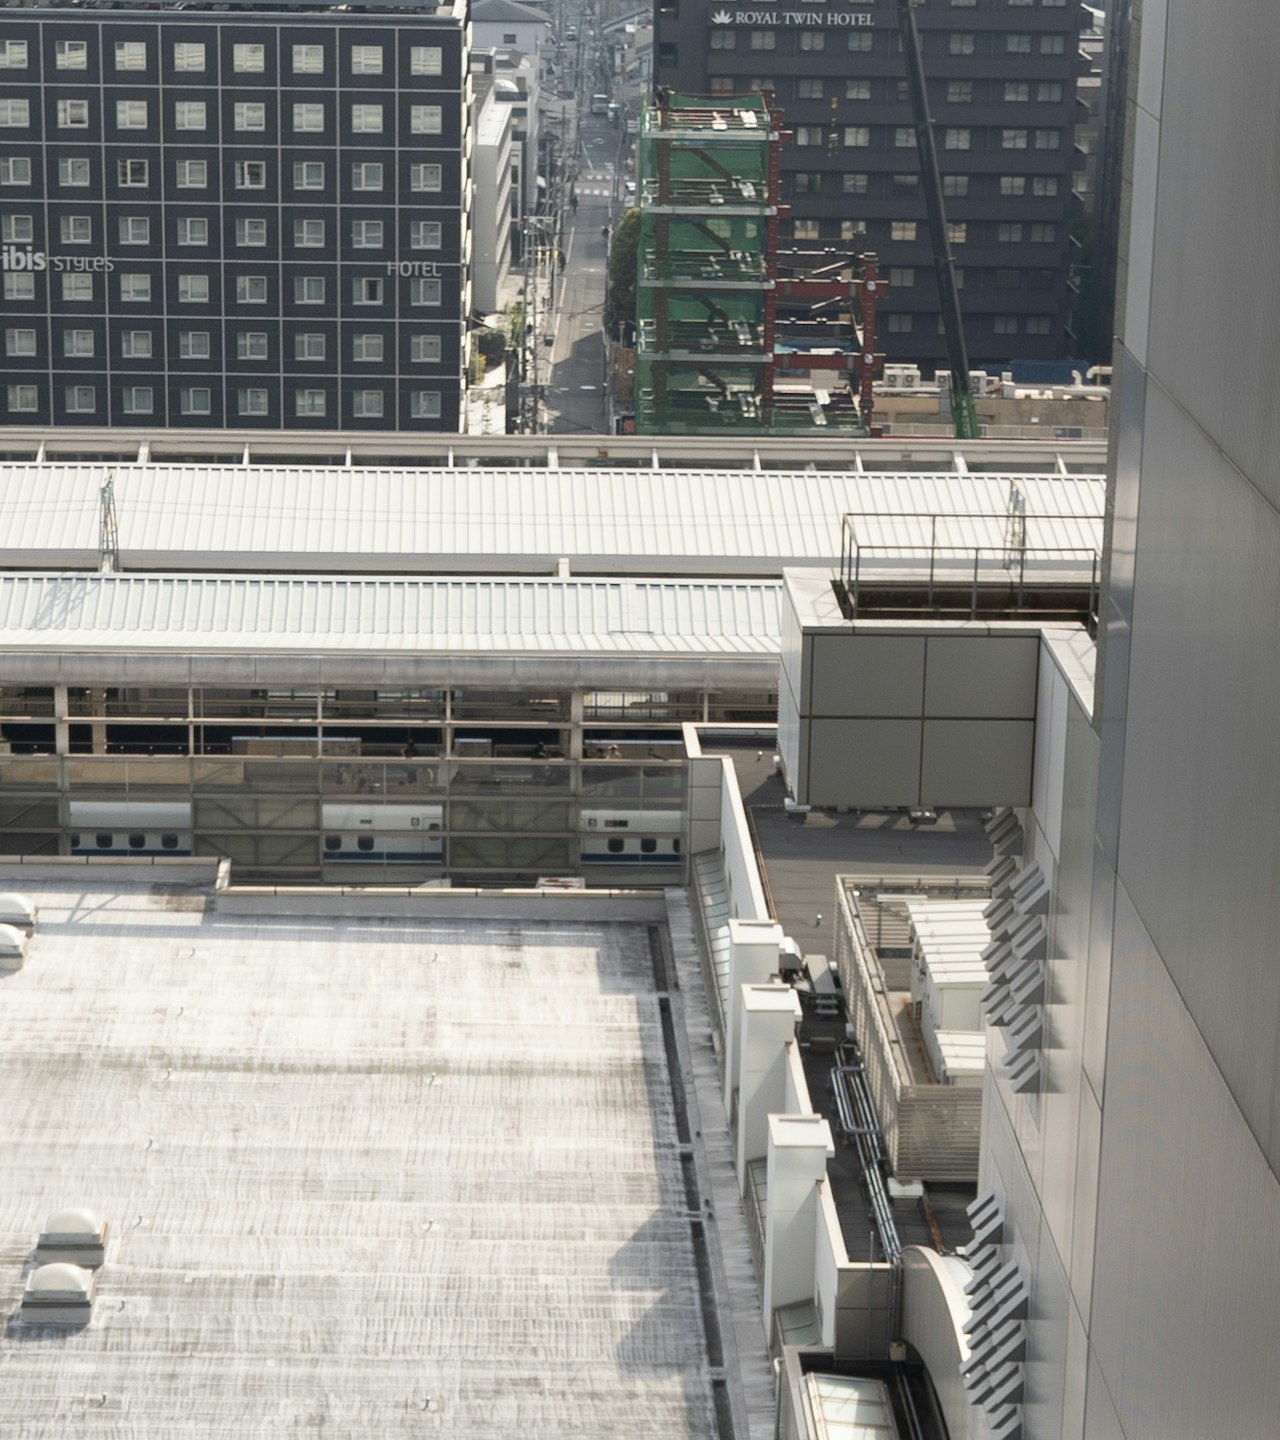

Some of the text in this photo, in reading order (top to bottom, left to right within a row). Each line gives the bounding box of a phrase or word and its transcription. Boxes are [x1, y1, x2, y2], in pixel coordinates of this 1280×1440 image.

[735, 11, 874, 26] ROYAL TWIN HOTEL
[2, 245, 46, 271] ibis
[387, 261, 442, 277] HOTEL
